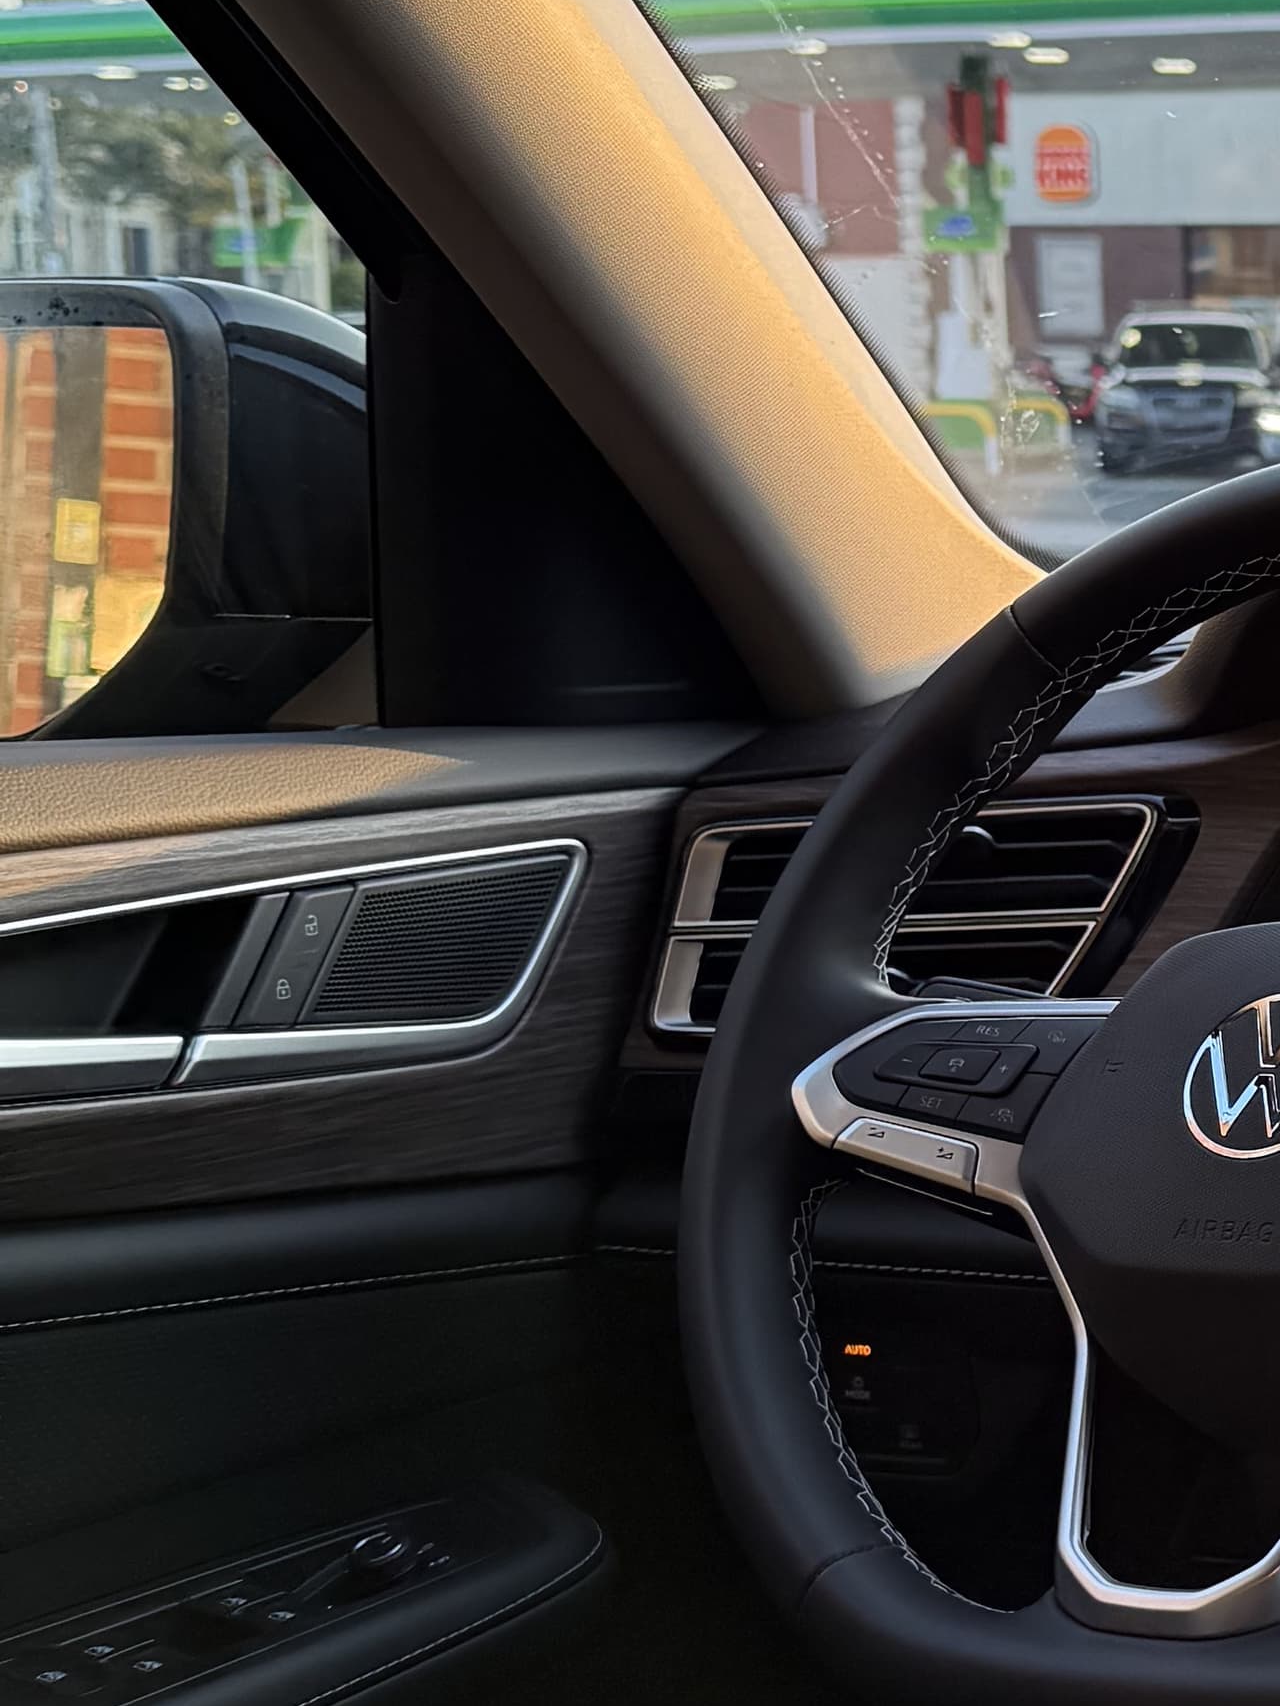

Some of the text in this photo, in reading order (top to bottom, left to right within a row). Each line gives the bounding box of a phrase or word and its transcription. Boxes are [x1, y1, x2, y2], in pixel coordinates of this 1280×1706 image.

[976, 1024, 1000, 1037] RES
[919, 1096, 943, 1109] SET
[1173, 1217, 1275, 1243] AIRBAG
[844, 1344, 872, 1356] AUTO
